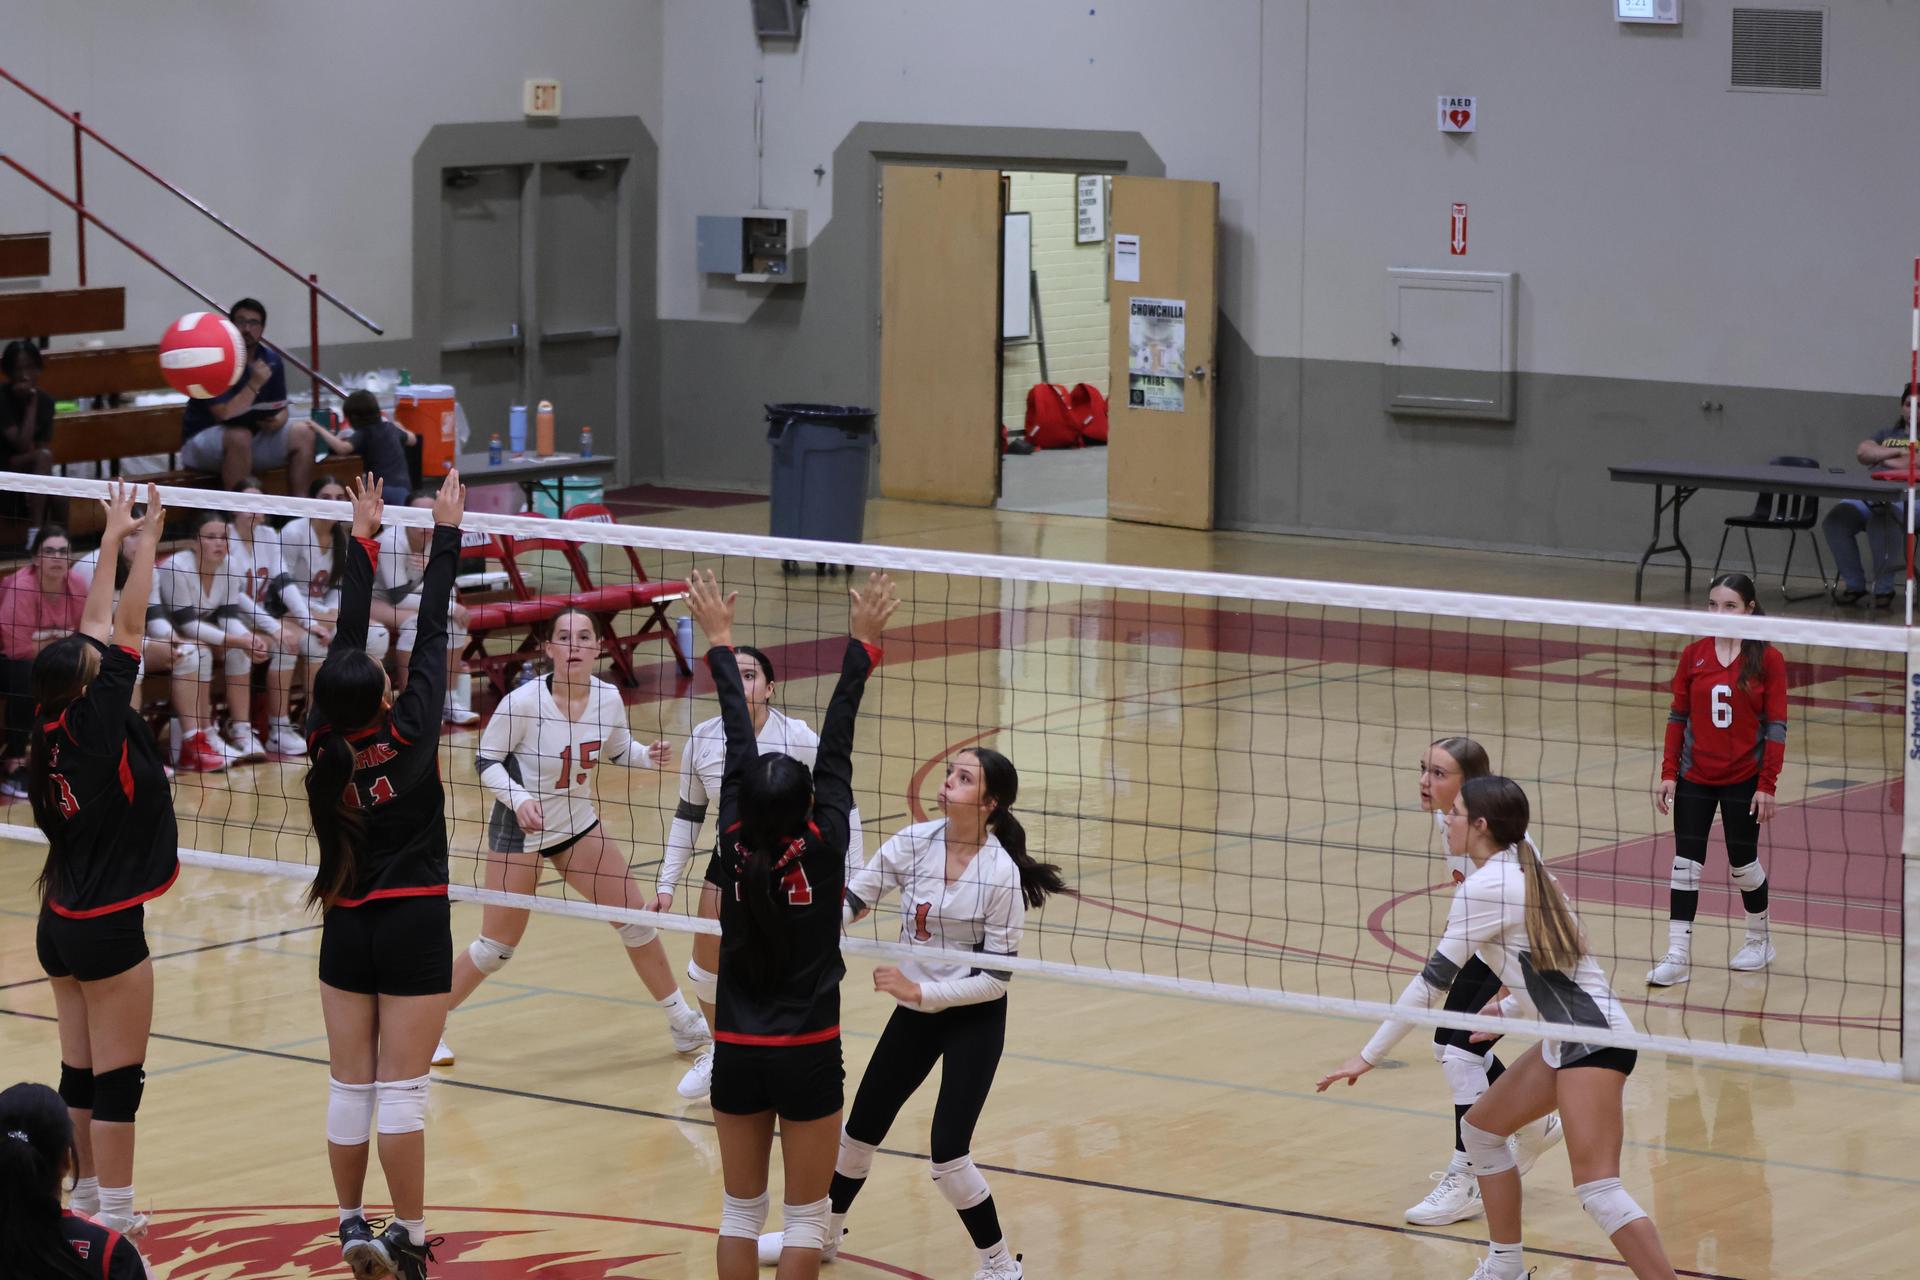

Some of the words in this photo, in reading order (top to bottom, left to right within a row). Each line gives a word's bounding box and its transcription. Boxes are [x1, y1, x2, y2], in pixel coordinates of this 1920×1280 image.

[1450, 98, 1472, 107] AED
[1131, 303, 1183, 319] CHOWCHILLA
[1711, 684, 1733, 729] 6
[555, 740, 602, 789] 15
[914, 901, 932, 942] 1
